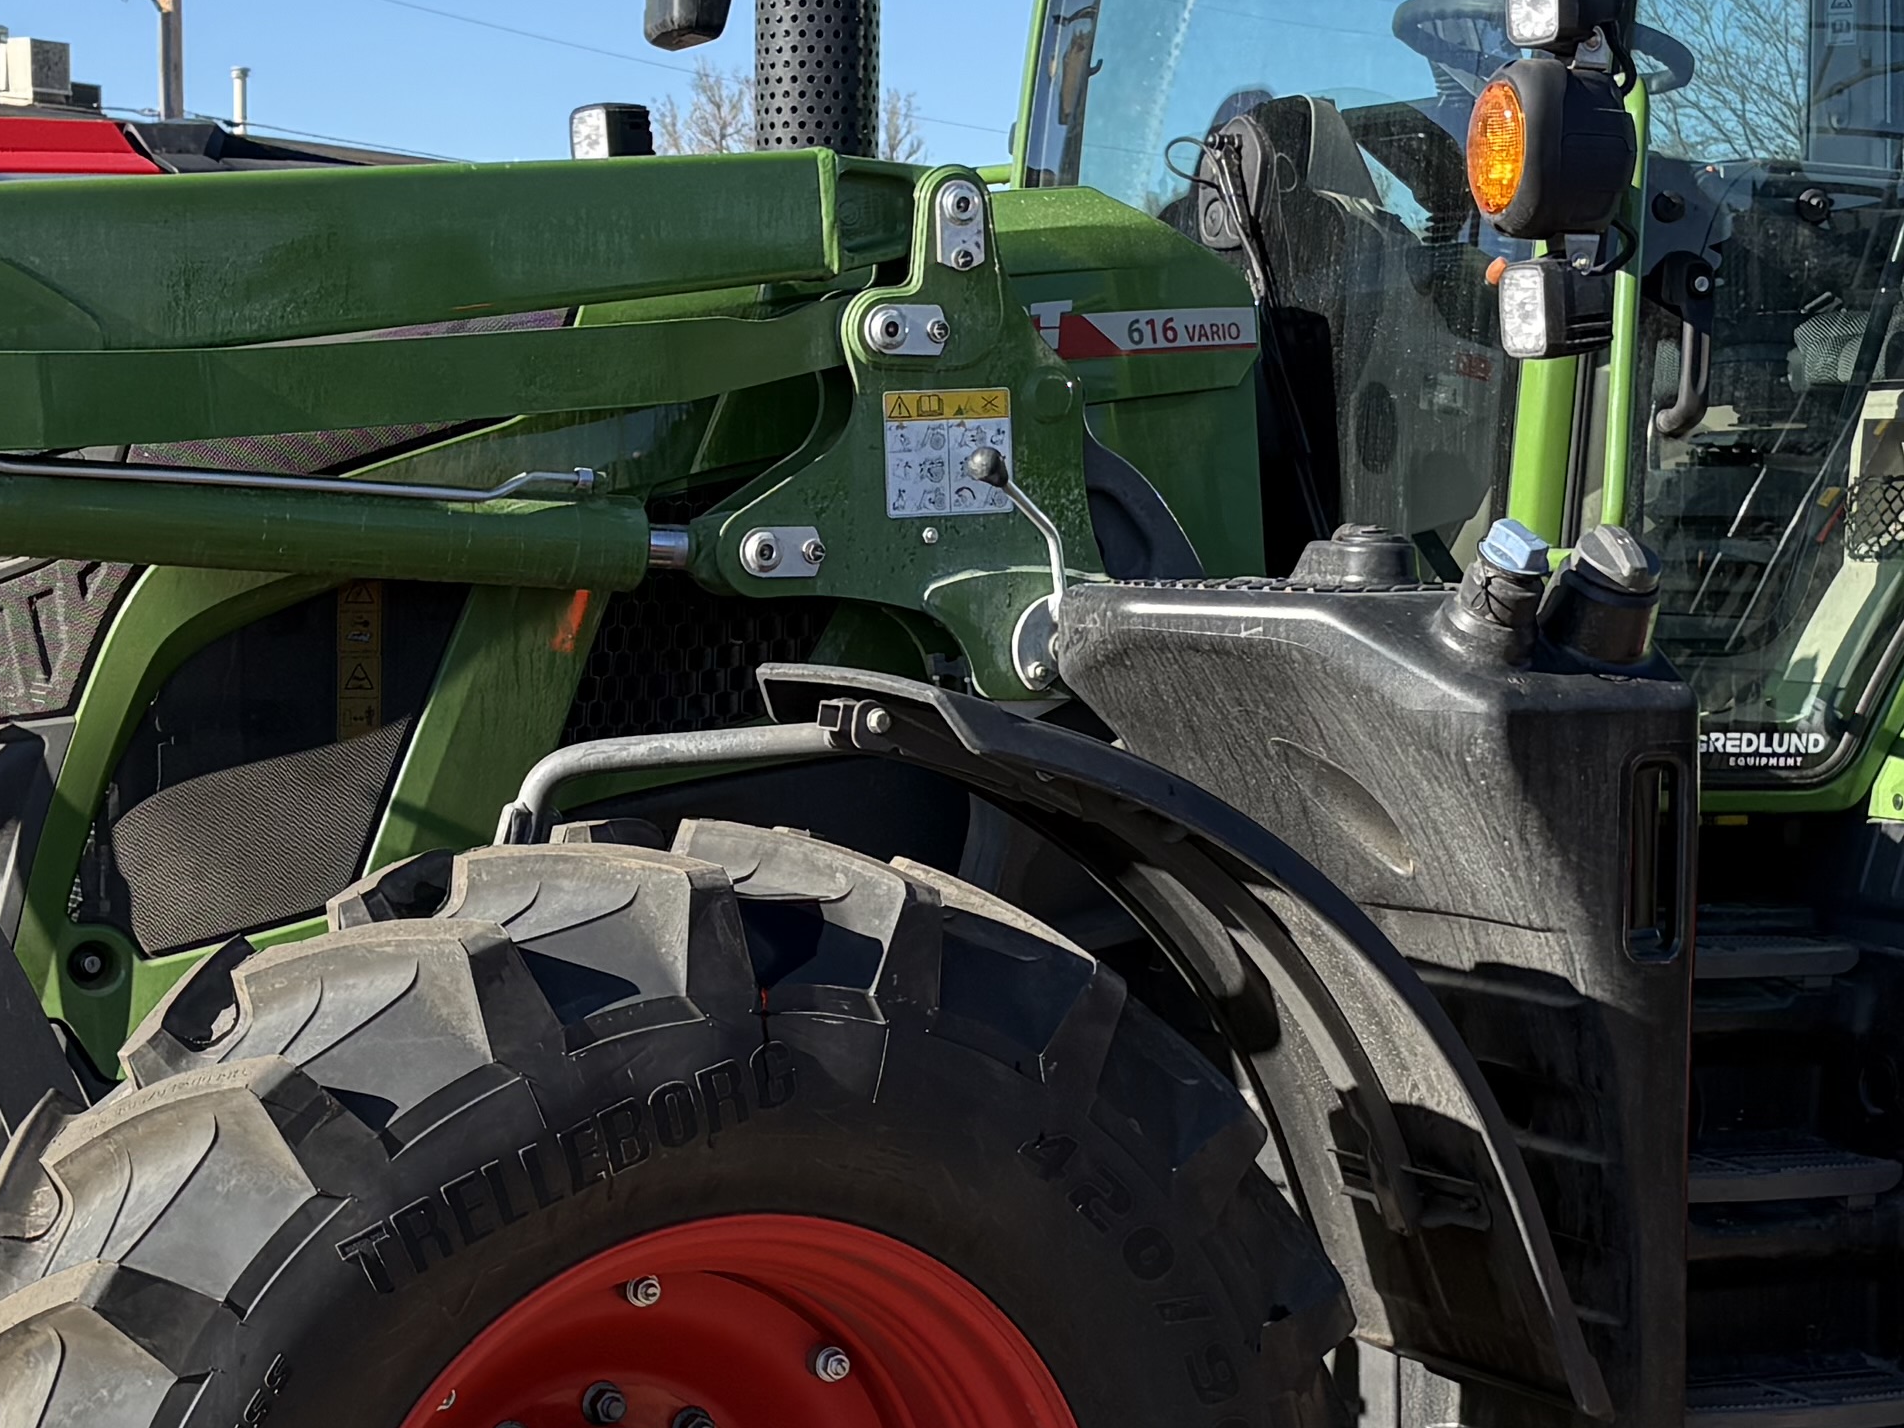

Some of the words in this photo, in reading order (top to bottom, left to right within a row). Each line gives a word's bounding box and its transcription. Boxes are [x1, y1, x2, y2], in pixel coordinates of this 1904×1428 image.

[1127, 317, 1178, 345] 616
[1184, 322, 1241, 343] VARIO
[1729, 756, 1803, 766] EQUIPMENT
[335, 1038, 798, 1294] TRELLEBORG
